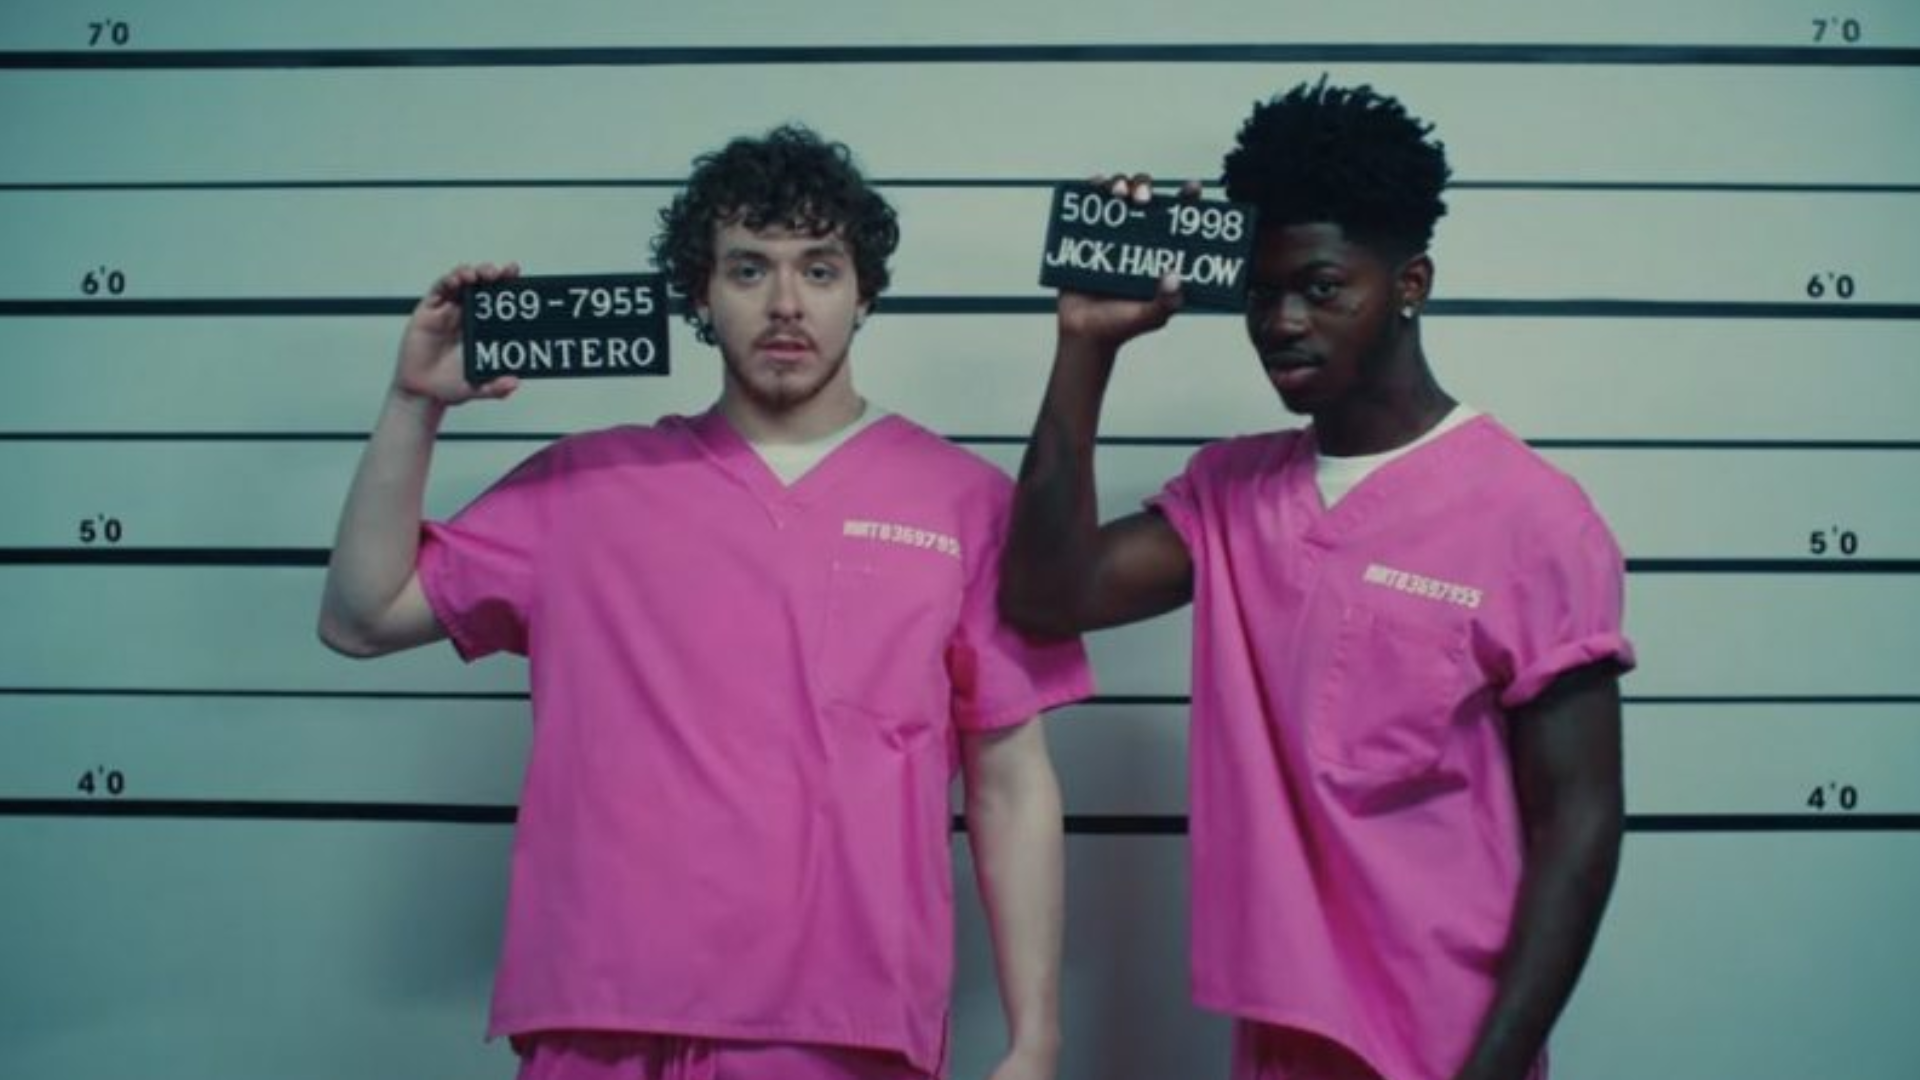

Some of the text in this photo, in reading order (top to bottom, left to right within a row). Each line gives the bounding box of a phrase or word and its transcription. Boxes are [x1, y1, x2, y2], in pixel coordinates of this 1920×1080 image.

[88, 19, 130, 47] 7'0
[1812, 17, 1862, 44] 7'0
[1168, 204, 1244, 242] 1998
[1046, 238, 1244, 288] JACK HARLOW
[81, 266, 126, 296] 6'0
[1806, 272, 1855, 300] 6'0
[475, 336, 656, 371] MONTERO
[79, 514, 123, 544] 5'0
[1809, 526, 1859, 556] 5'0
[77, 766, 125, 796] 4'0
[1806, 782, 1858, 811] 4'0
